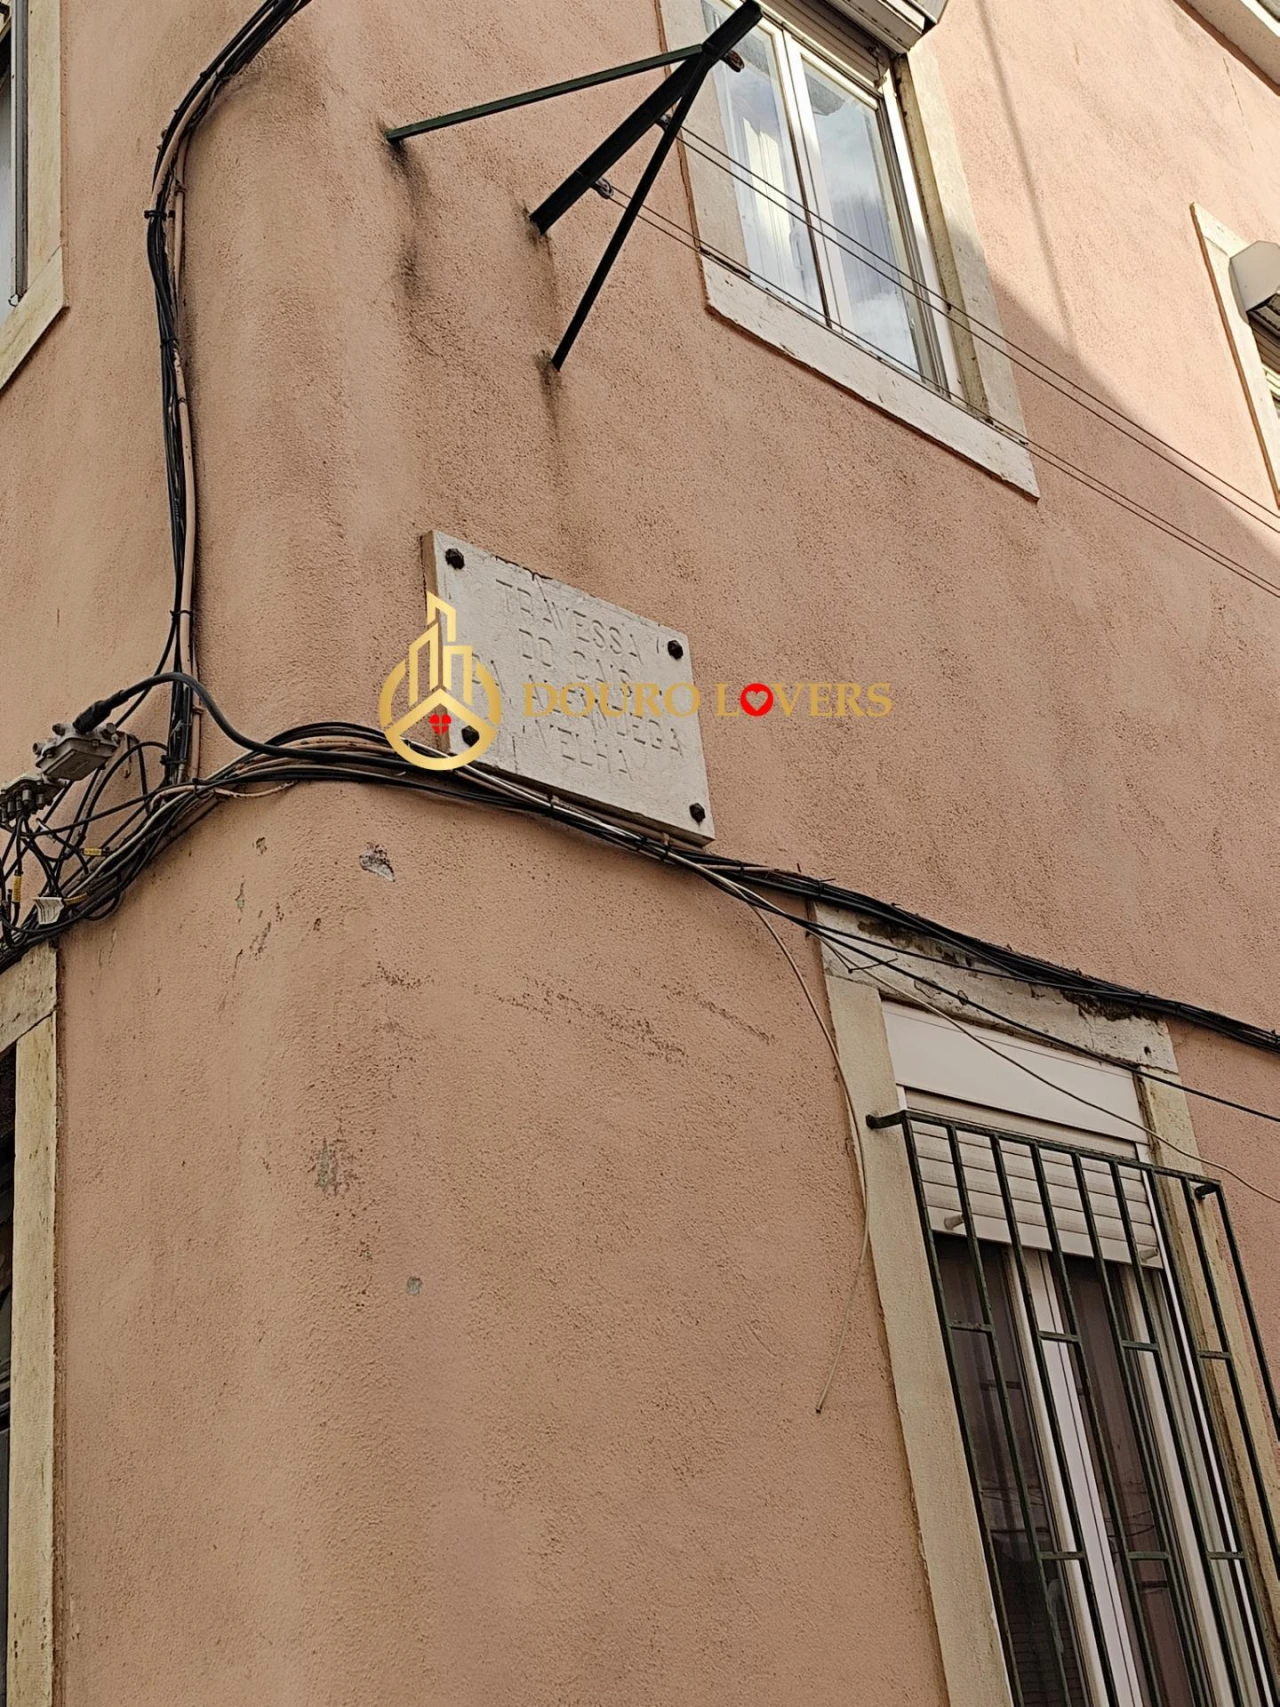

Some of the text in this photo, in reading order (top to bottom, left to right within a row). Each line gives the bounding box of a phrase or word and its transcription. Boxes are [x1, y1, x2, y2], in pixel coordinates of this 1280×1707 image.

[494, 577, 644, 665] TRAVESSA
[517, 626, 634, 700] DO CAIS
[533, 718, 634, 782] VELHA
